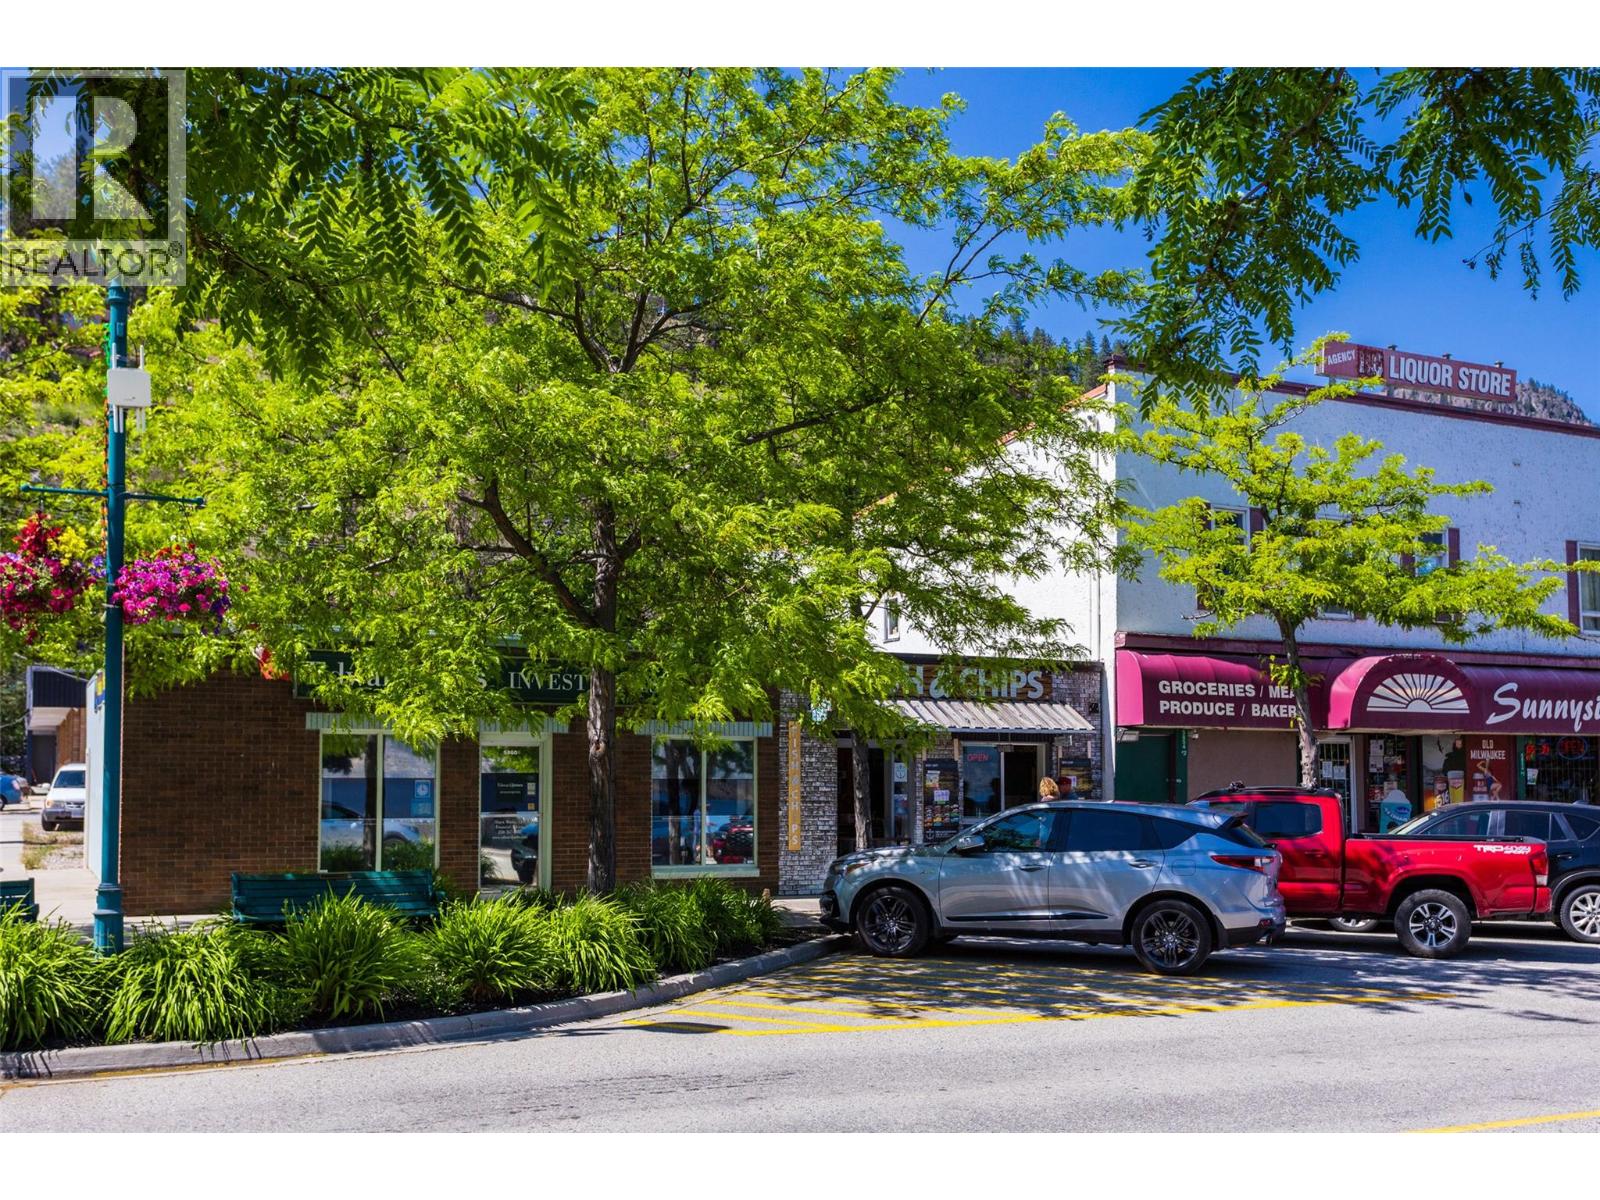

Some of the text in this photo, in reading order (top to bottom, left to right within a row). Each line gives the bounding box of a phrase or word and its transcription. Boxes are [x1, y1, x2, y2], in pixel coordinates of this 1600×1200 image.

[1327, 349, 1356, 366] AGENCY
[1389, 355, 1453, 387] LIQUOR
[1458, 366, 1512, 396] STORE
[508, 671, 587, 691] INVEST
[961, 669, 1044, 699] CHIPS
[1158, 680, 1256, 697] GROCERIES
[1159, 701, 1235, 716] PRODUCE
[1251, 703, 1297, 718] BAKER
[1482, 739, 1494, 749] OLD
